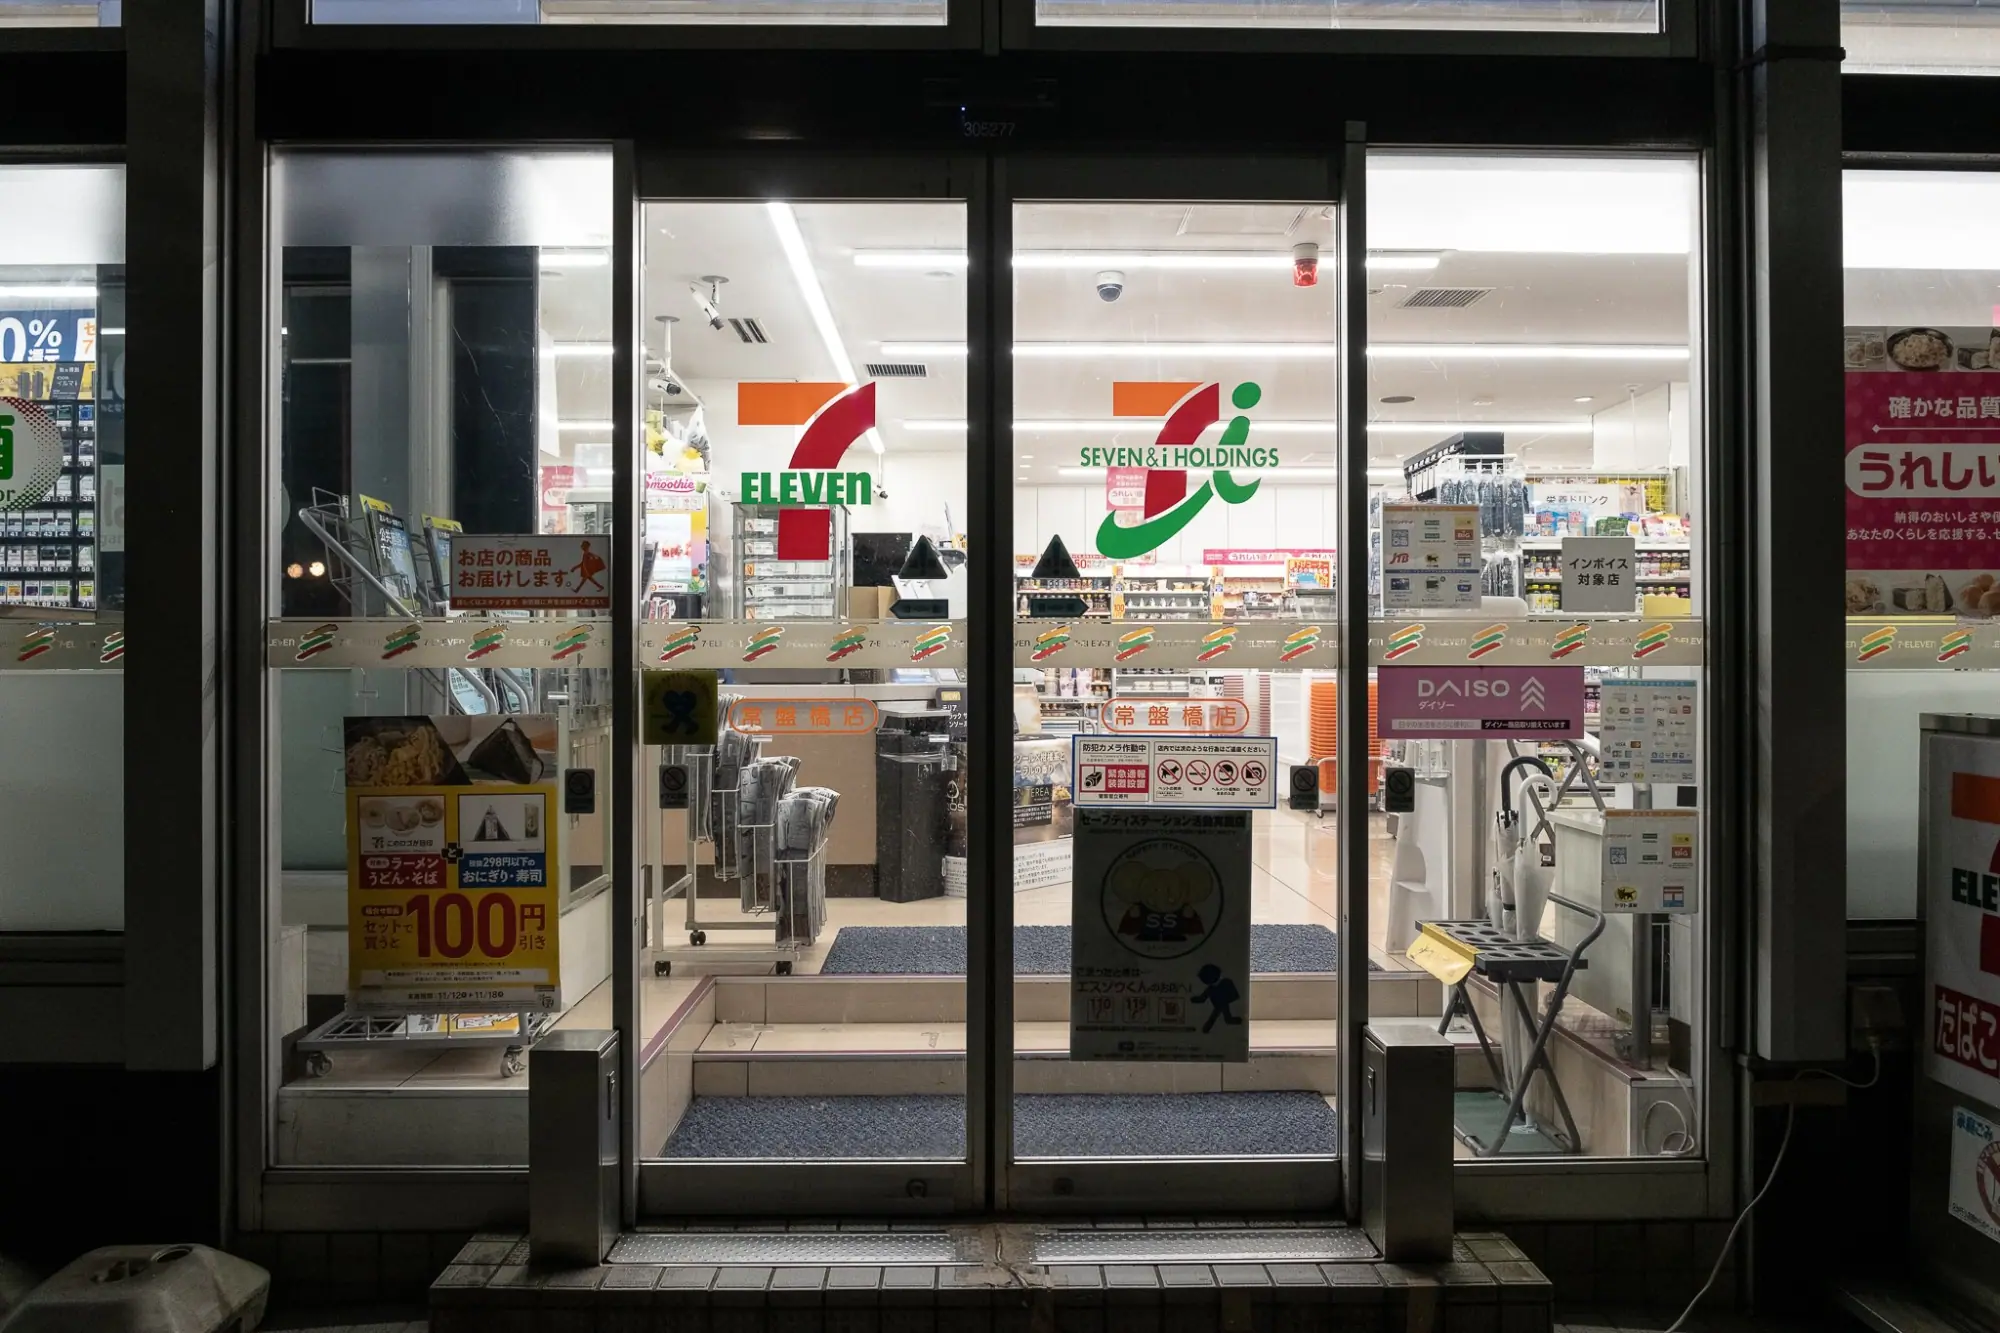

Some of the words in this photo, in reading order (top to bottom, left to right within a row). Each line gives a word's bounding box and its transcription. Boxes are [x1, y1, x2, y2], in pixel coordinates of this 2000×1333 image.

[963, 121, 1016, 137] 305277
[1889, 396, 2000, 419] 確かな品質
[1174, 447, 1280, 467] HOLDINGS
[458, 549, 552, 567] お店の商品
[1569, 558, 1629, 570] インボイス
[458, 570, 572, 588] お届けします。
[1577, 574, 1620, 586] 対象店
[1418, 700, 1455, 710] ダイソー
[1114, 705, 1236, 727] 常盤橋店
[1082, 743, 1147, 753] 防犯カメラ作動中
[391, 856, 439, 870] ラーメン
[368, 871, 439, 887] うどん・そば
[462, 868, 543, 884] おにぎり・寿司
[407, 892, 517, 959] 100
[519, 903, 546, 933] 円
[362, 919, 414, 935] セットで
[1936, 992, 1998, 1071] たばこ
